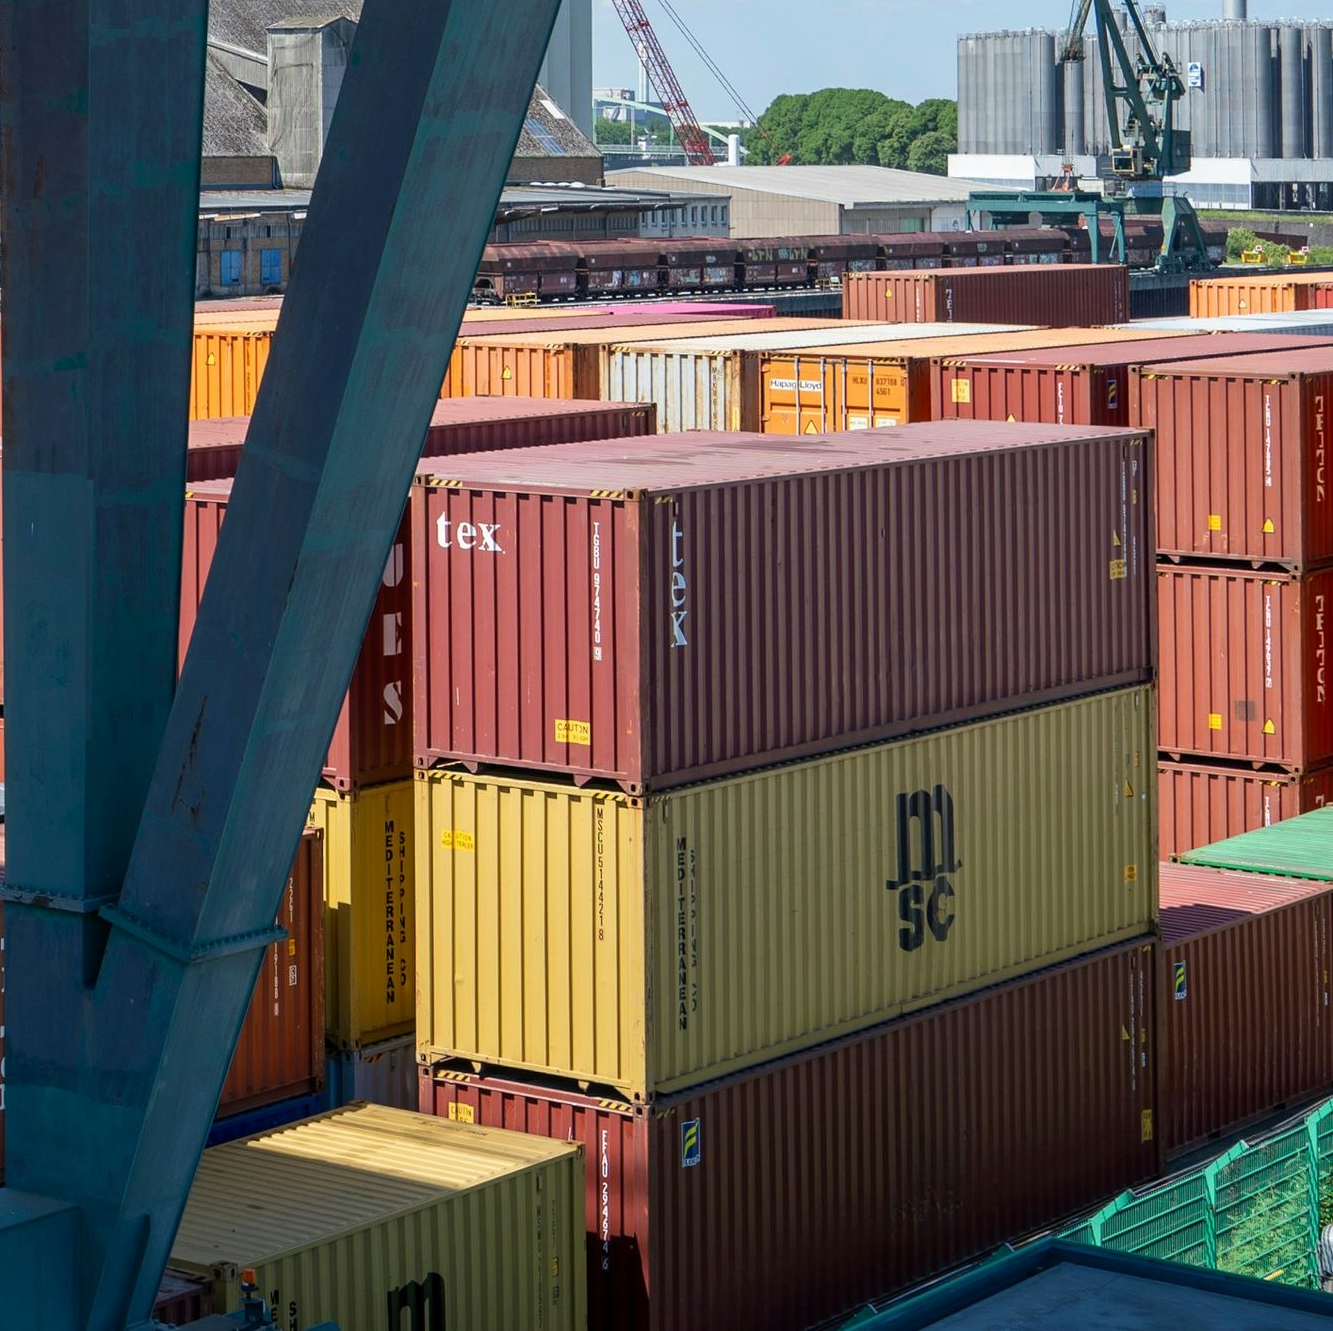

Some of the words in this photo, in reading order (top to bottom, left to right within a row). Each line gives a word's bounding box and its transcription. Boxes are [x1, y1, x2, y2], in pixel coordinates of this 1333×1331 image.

[593, 522, 601, 570] TGBU
[593, 573, 602, 644] 974740
[385, 821, 395, 1004] MEDITERRANEAN
[677, 837, 687, 1031] MEDITERRANEAN
